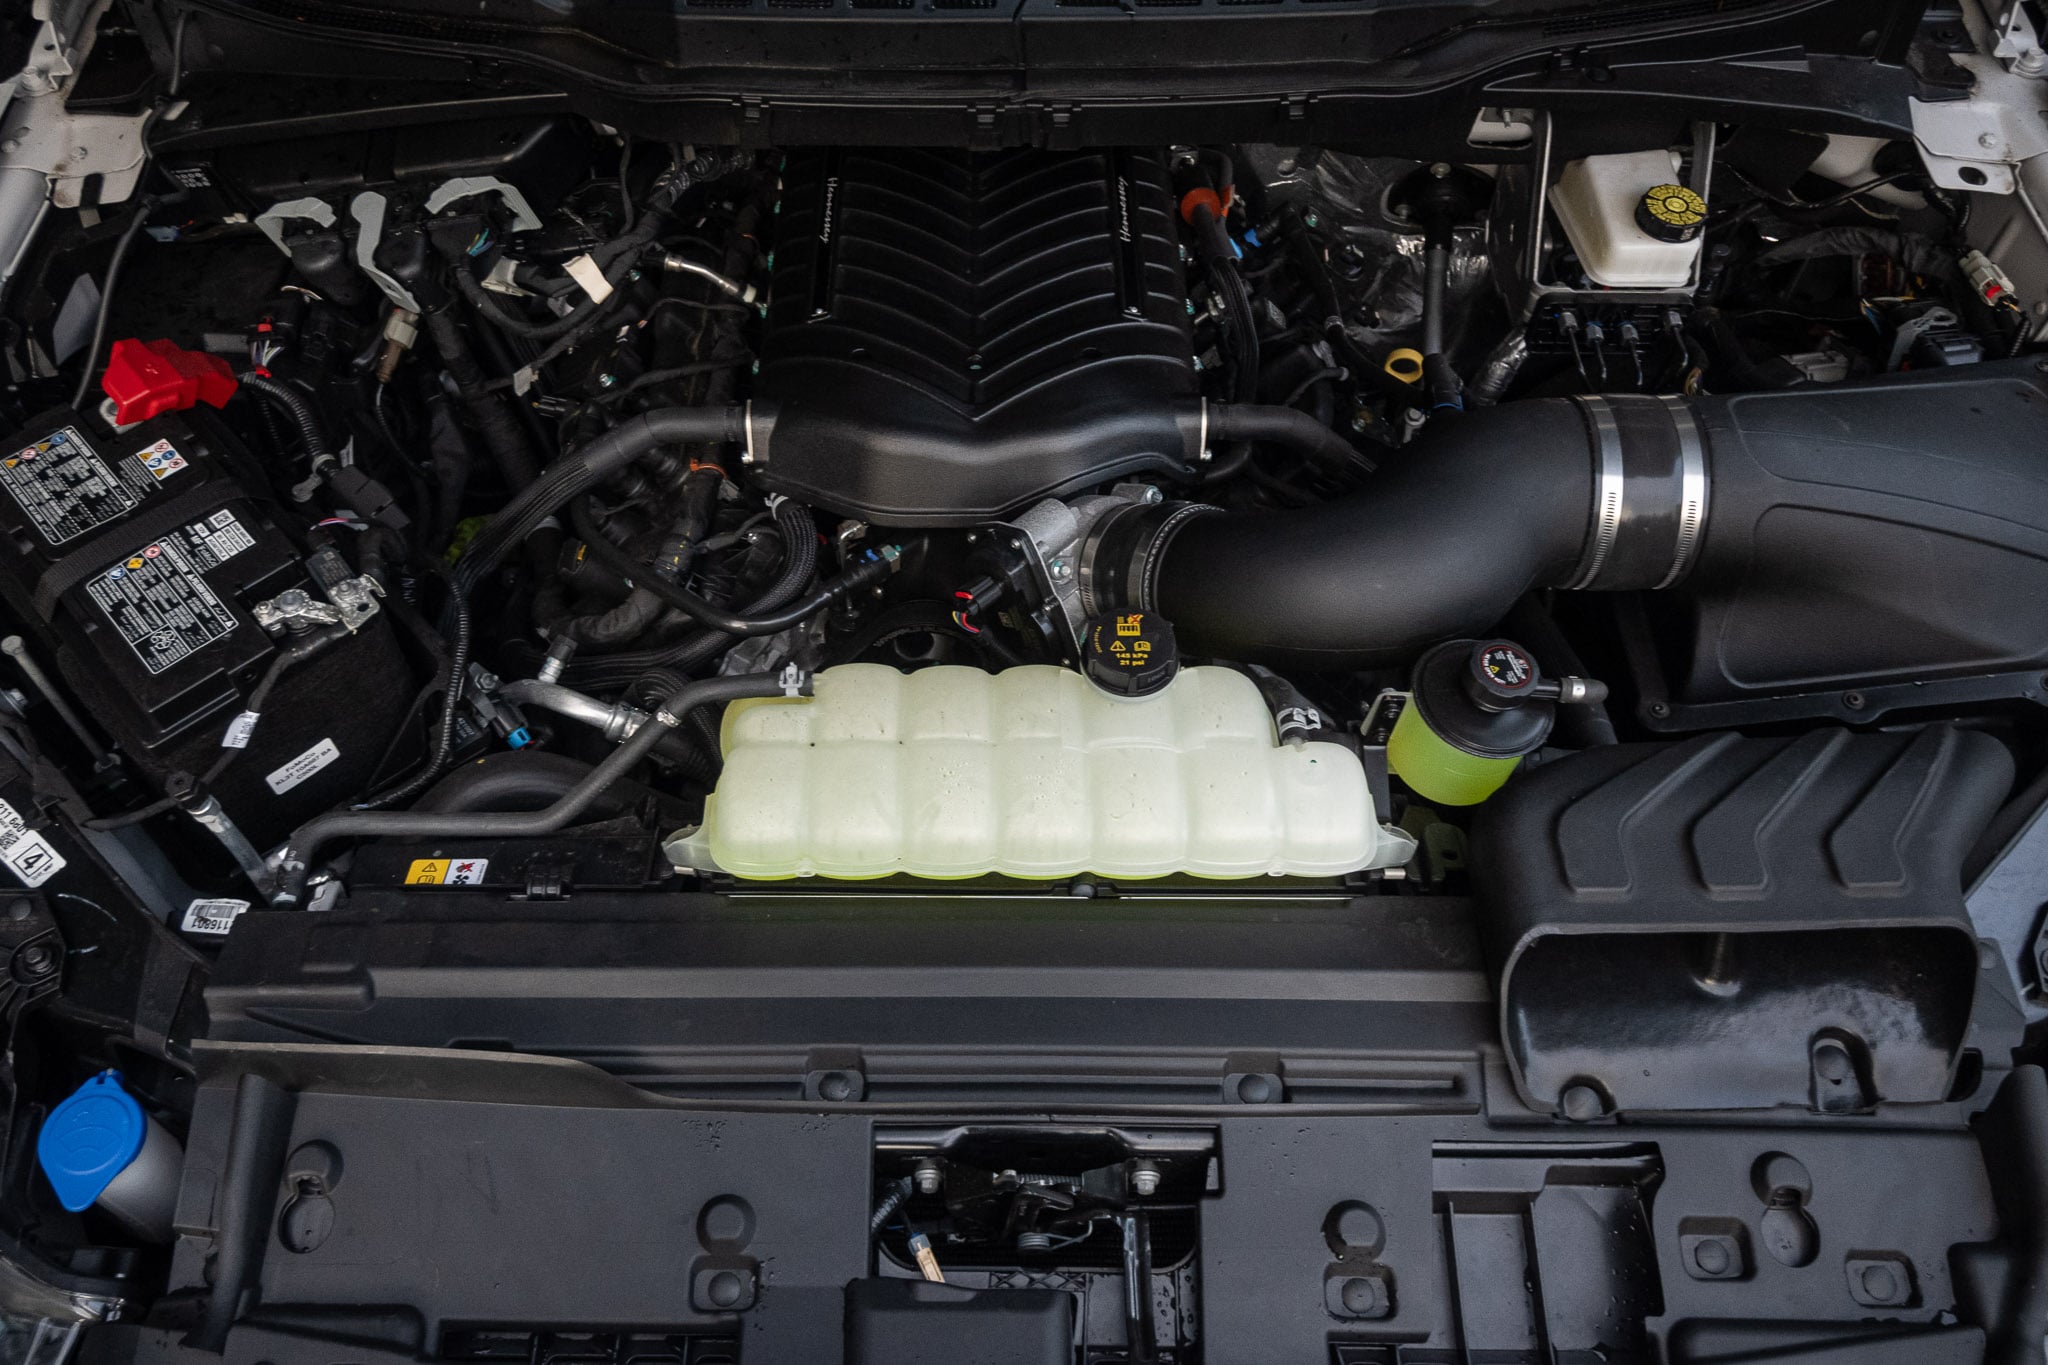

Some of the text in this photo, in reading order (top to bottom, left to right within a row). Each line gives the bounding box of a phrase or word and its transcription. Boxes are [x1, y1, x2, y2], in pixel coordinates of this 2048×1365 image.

[819, 177, 838, 243] Hennessey
[1118, 176, 1131, 242] Hennessey
[24, 853, 45, 871] 4
